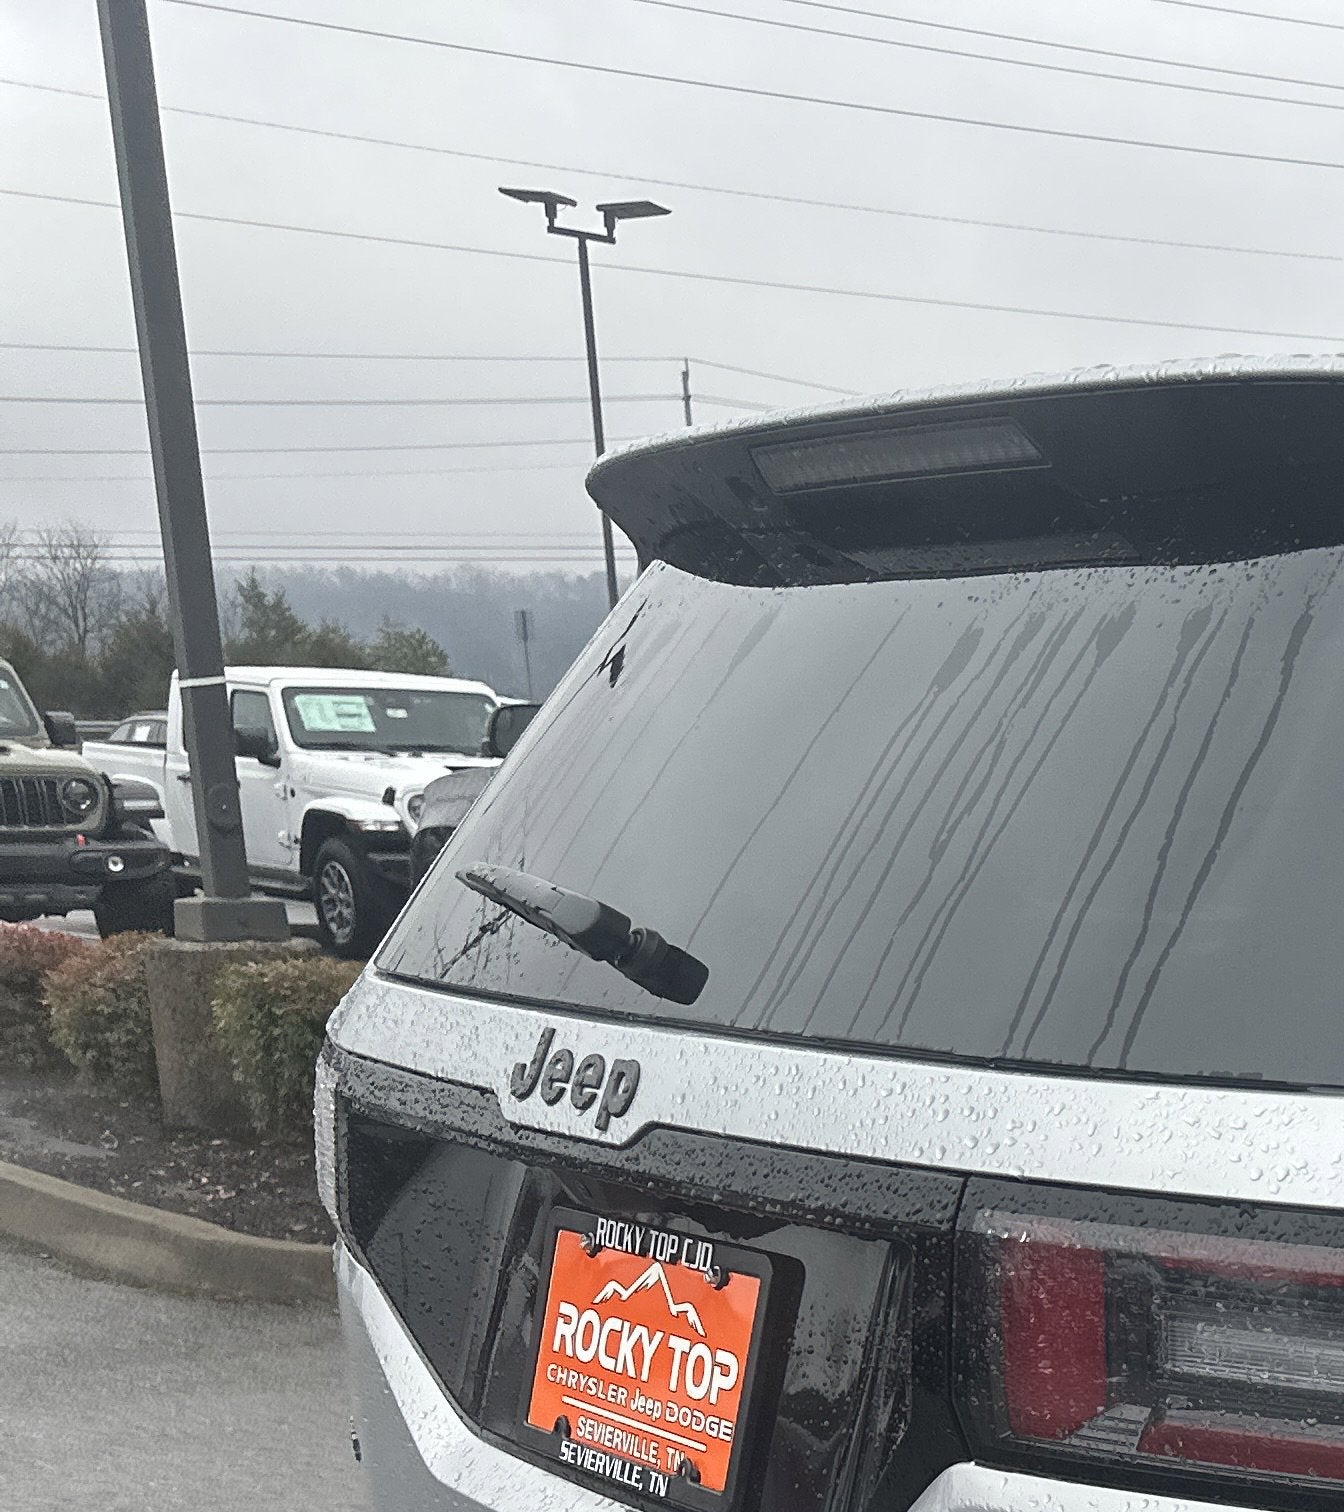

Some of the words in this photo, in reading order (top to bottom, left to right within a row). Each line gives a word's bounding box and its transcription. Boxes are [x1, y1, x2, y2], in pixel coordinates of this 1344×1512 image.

[510, 1026, 641, 1132] Jeep
[595, 1217, 645, 1255] ROCKY
[648, 1230, 679, 1262] TOP
[552, 1300, 665, 1383] ROCKY
[667, 1333, 739, 1405] TOP
[546, 1362, 629, 1408] CHRYSLER
[630, 1387, 663, 1422] Jeep
[664, 1400, 736, 1442] DODGE
[558, 1440, 643, 1491] SEVIERVILLE,
[648, 1470, 669, 1498] TN
[576, 1415, 661, 1469] SEVIERVILLE,
